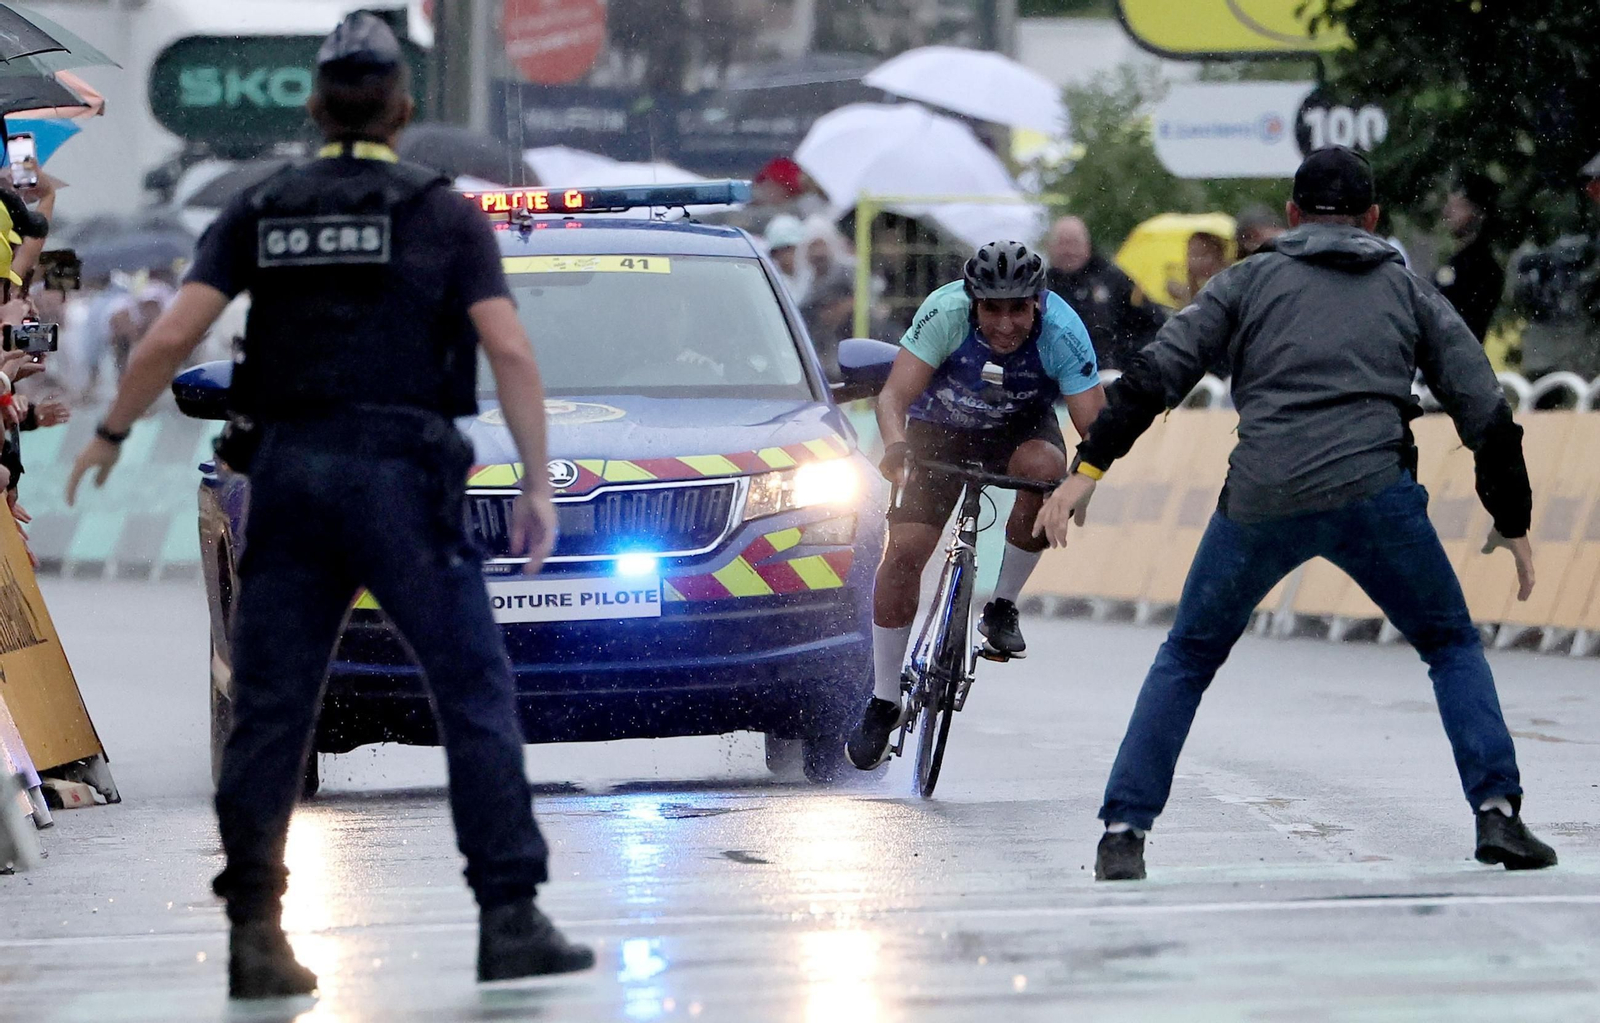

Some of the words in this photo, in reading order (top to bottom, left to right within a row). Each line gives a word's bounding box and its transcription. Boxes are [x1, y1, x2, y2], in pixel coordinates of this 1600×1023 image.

[179, 67, 313, 107] SKO
[1303, 105, 1388, 150] 100
[266, 228, 309, 254] GO
[318, 226, 380, 252] CRS
[619, 258, 649, 270] 41
[491, 593, 573, 610] OITURE
[580, 589, 659, 607] PILOTE
